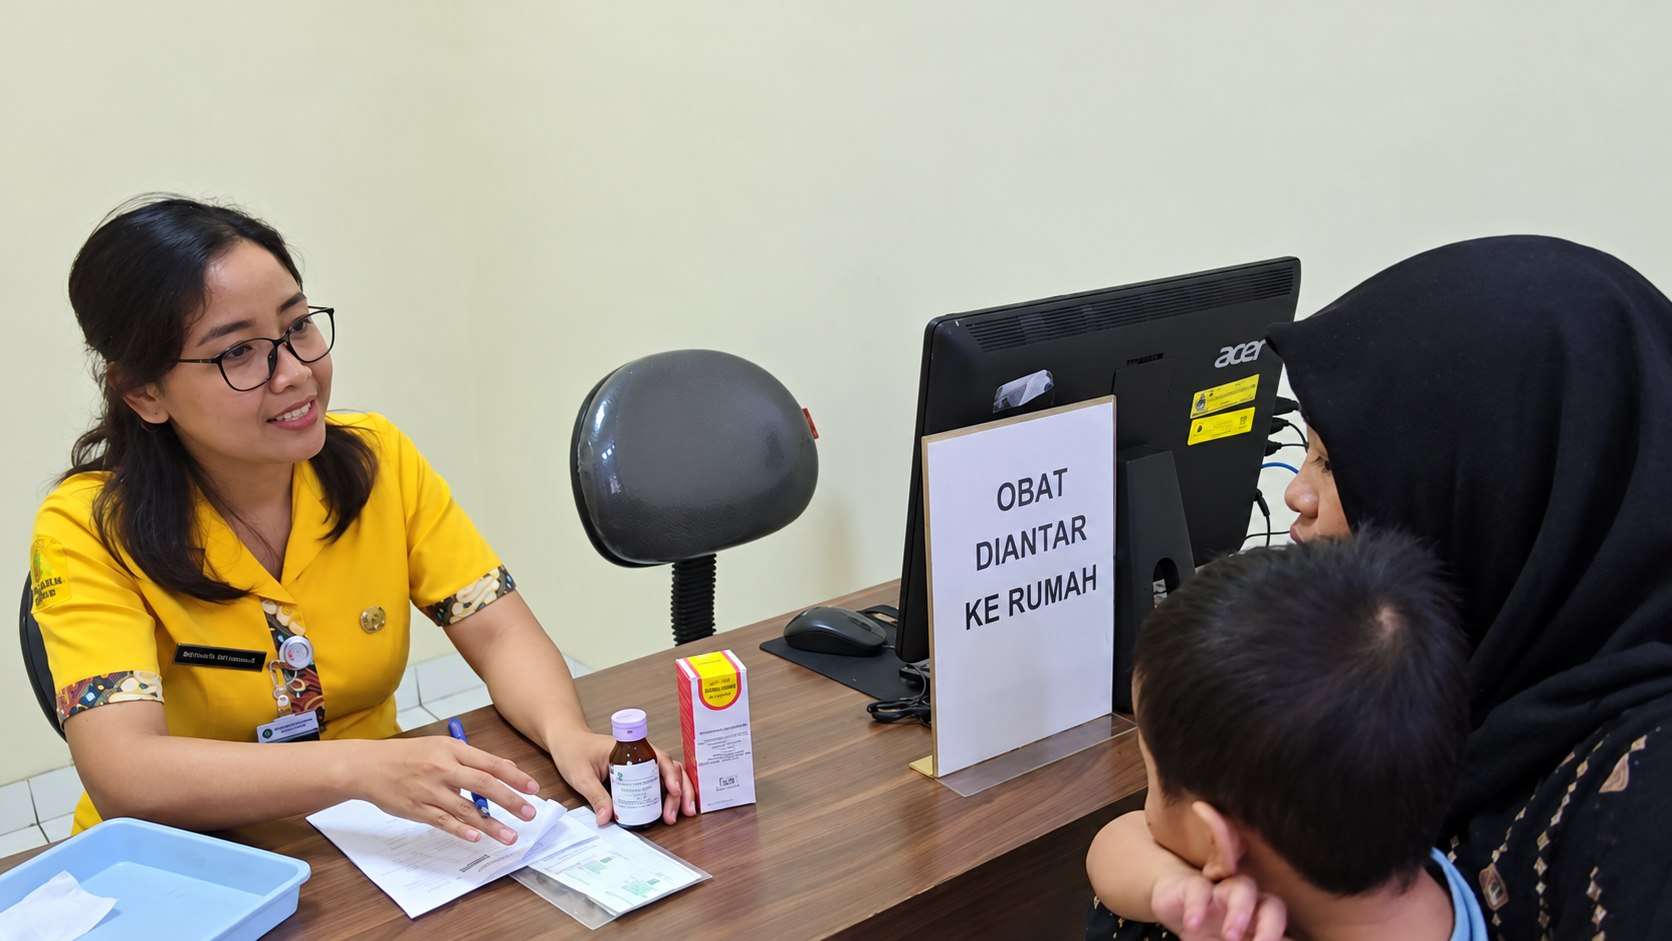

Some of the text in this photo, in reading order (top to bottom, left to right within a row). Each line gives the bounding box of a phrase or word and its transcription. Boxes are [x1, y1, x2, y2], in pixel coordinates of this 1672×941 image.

[1214, 339, 1266, 368] acer
[997, 468, 1068, 511] OBAT
[976, 515, 1087, 571] DIANTAR
[965, 564, 1097, 630] KE RUMAH
